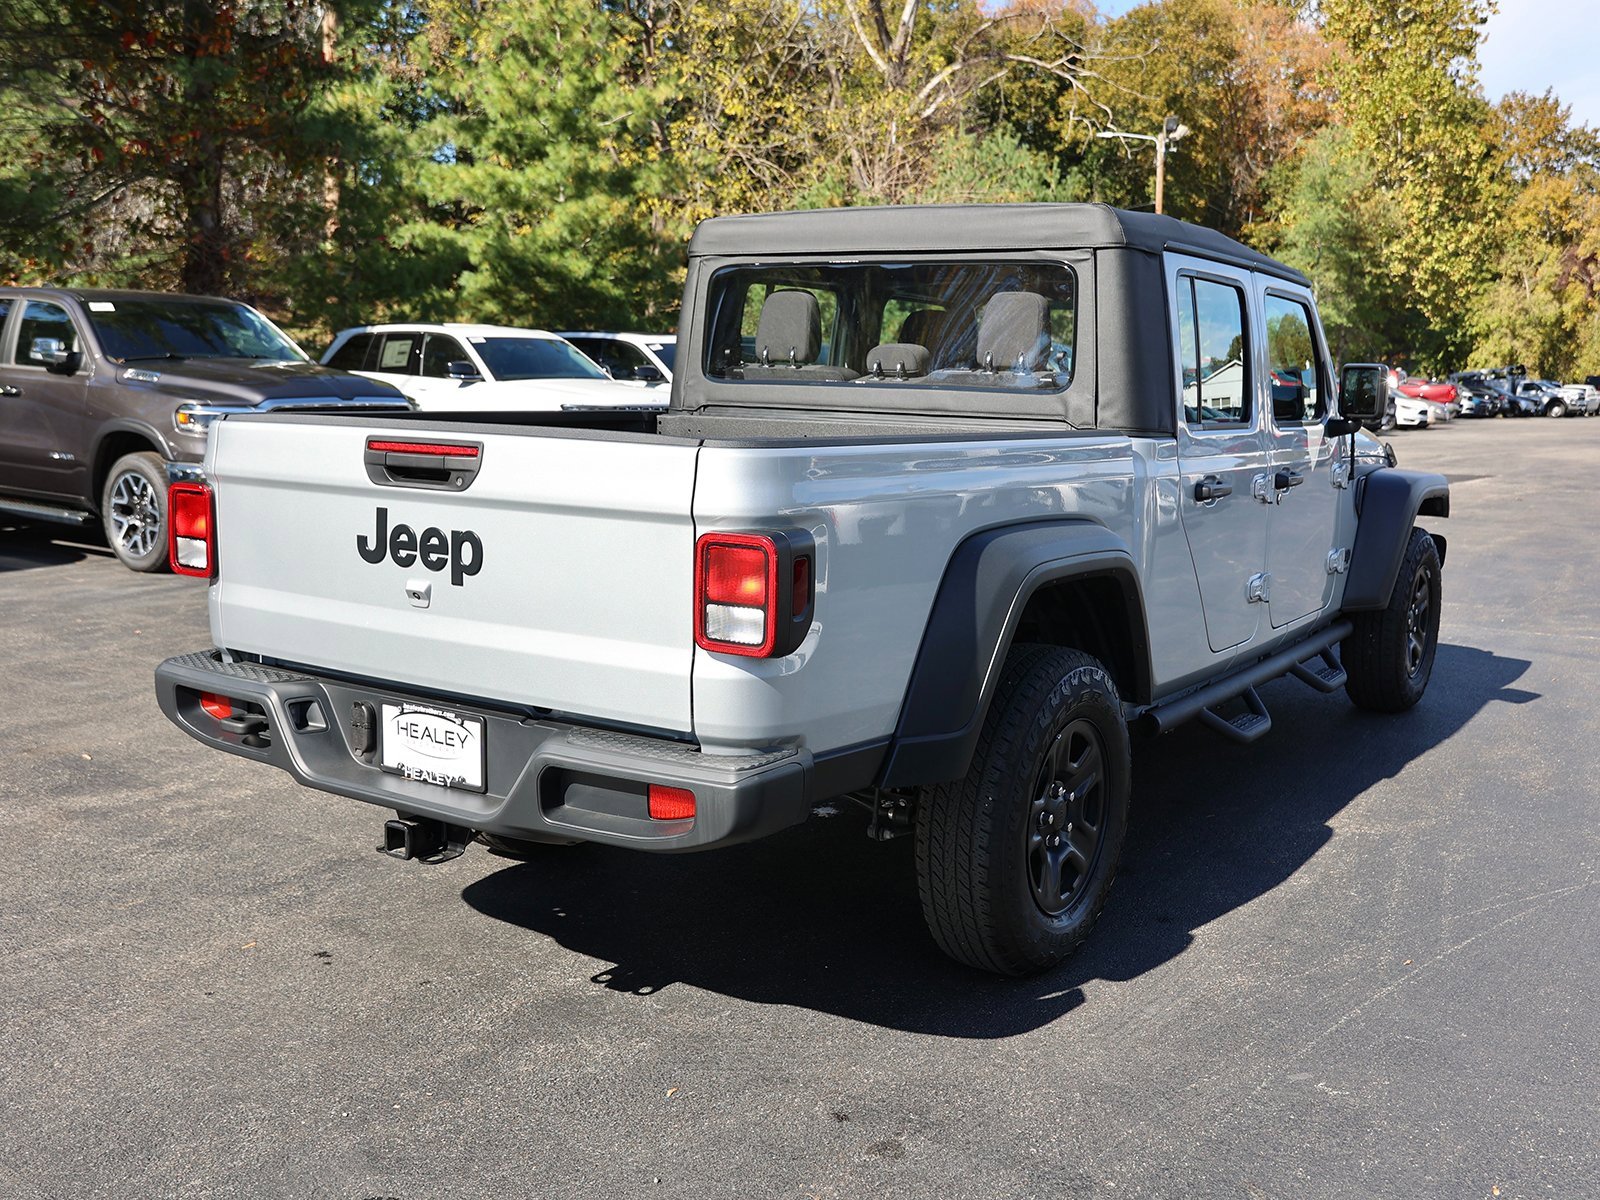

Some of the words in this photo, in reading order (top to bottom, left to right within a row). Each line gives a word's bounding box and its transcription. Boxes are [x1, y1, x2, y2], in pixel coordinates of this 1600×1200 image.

[357, 507, 483, 586] Jeep
[397, 720, 468, 748] HEALEY
[404, 767, 454, 787] HEALEY
